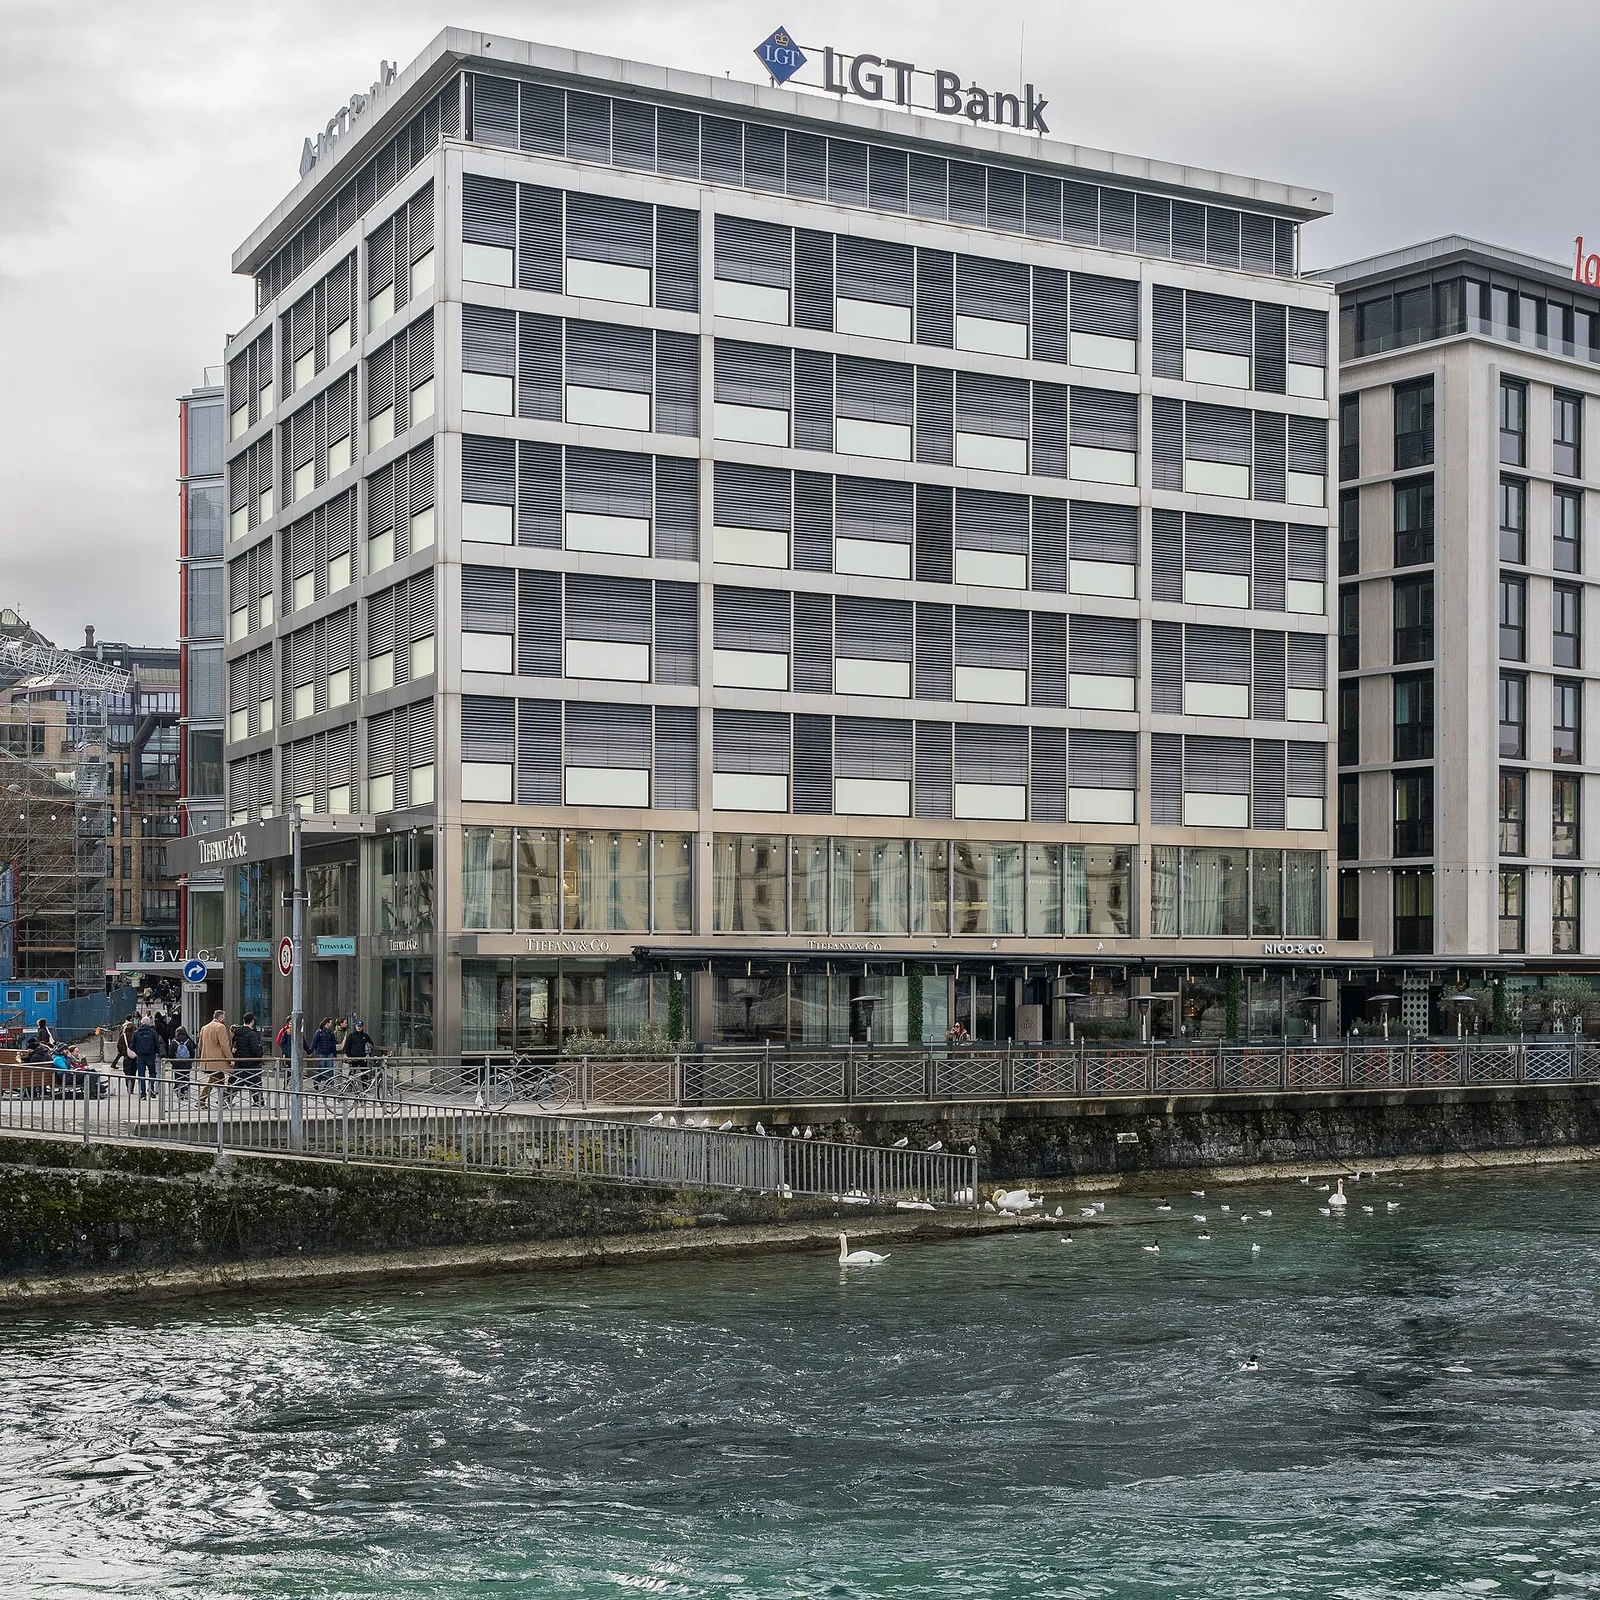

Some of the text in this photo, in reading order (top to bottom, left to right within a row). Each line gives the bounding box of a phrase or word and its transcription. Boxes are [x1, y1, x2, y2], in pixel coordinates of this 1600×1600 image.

[765, 44, 799, 67] LGT
[823, 46, 1050, 133] LGT Bank
[1263, 943, 1328, 954] NICO & CO.
